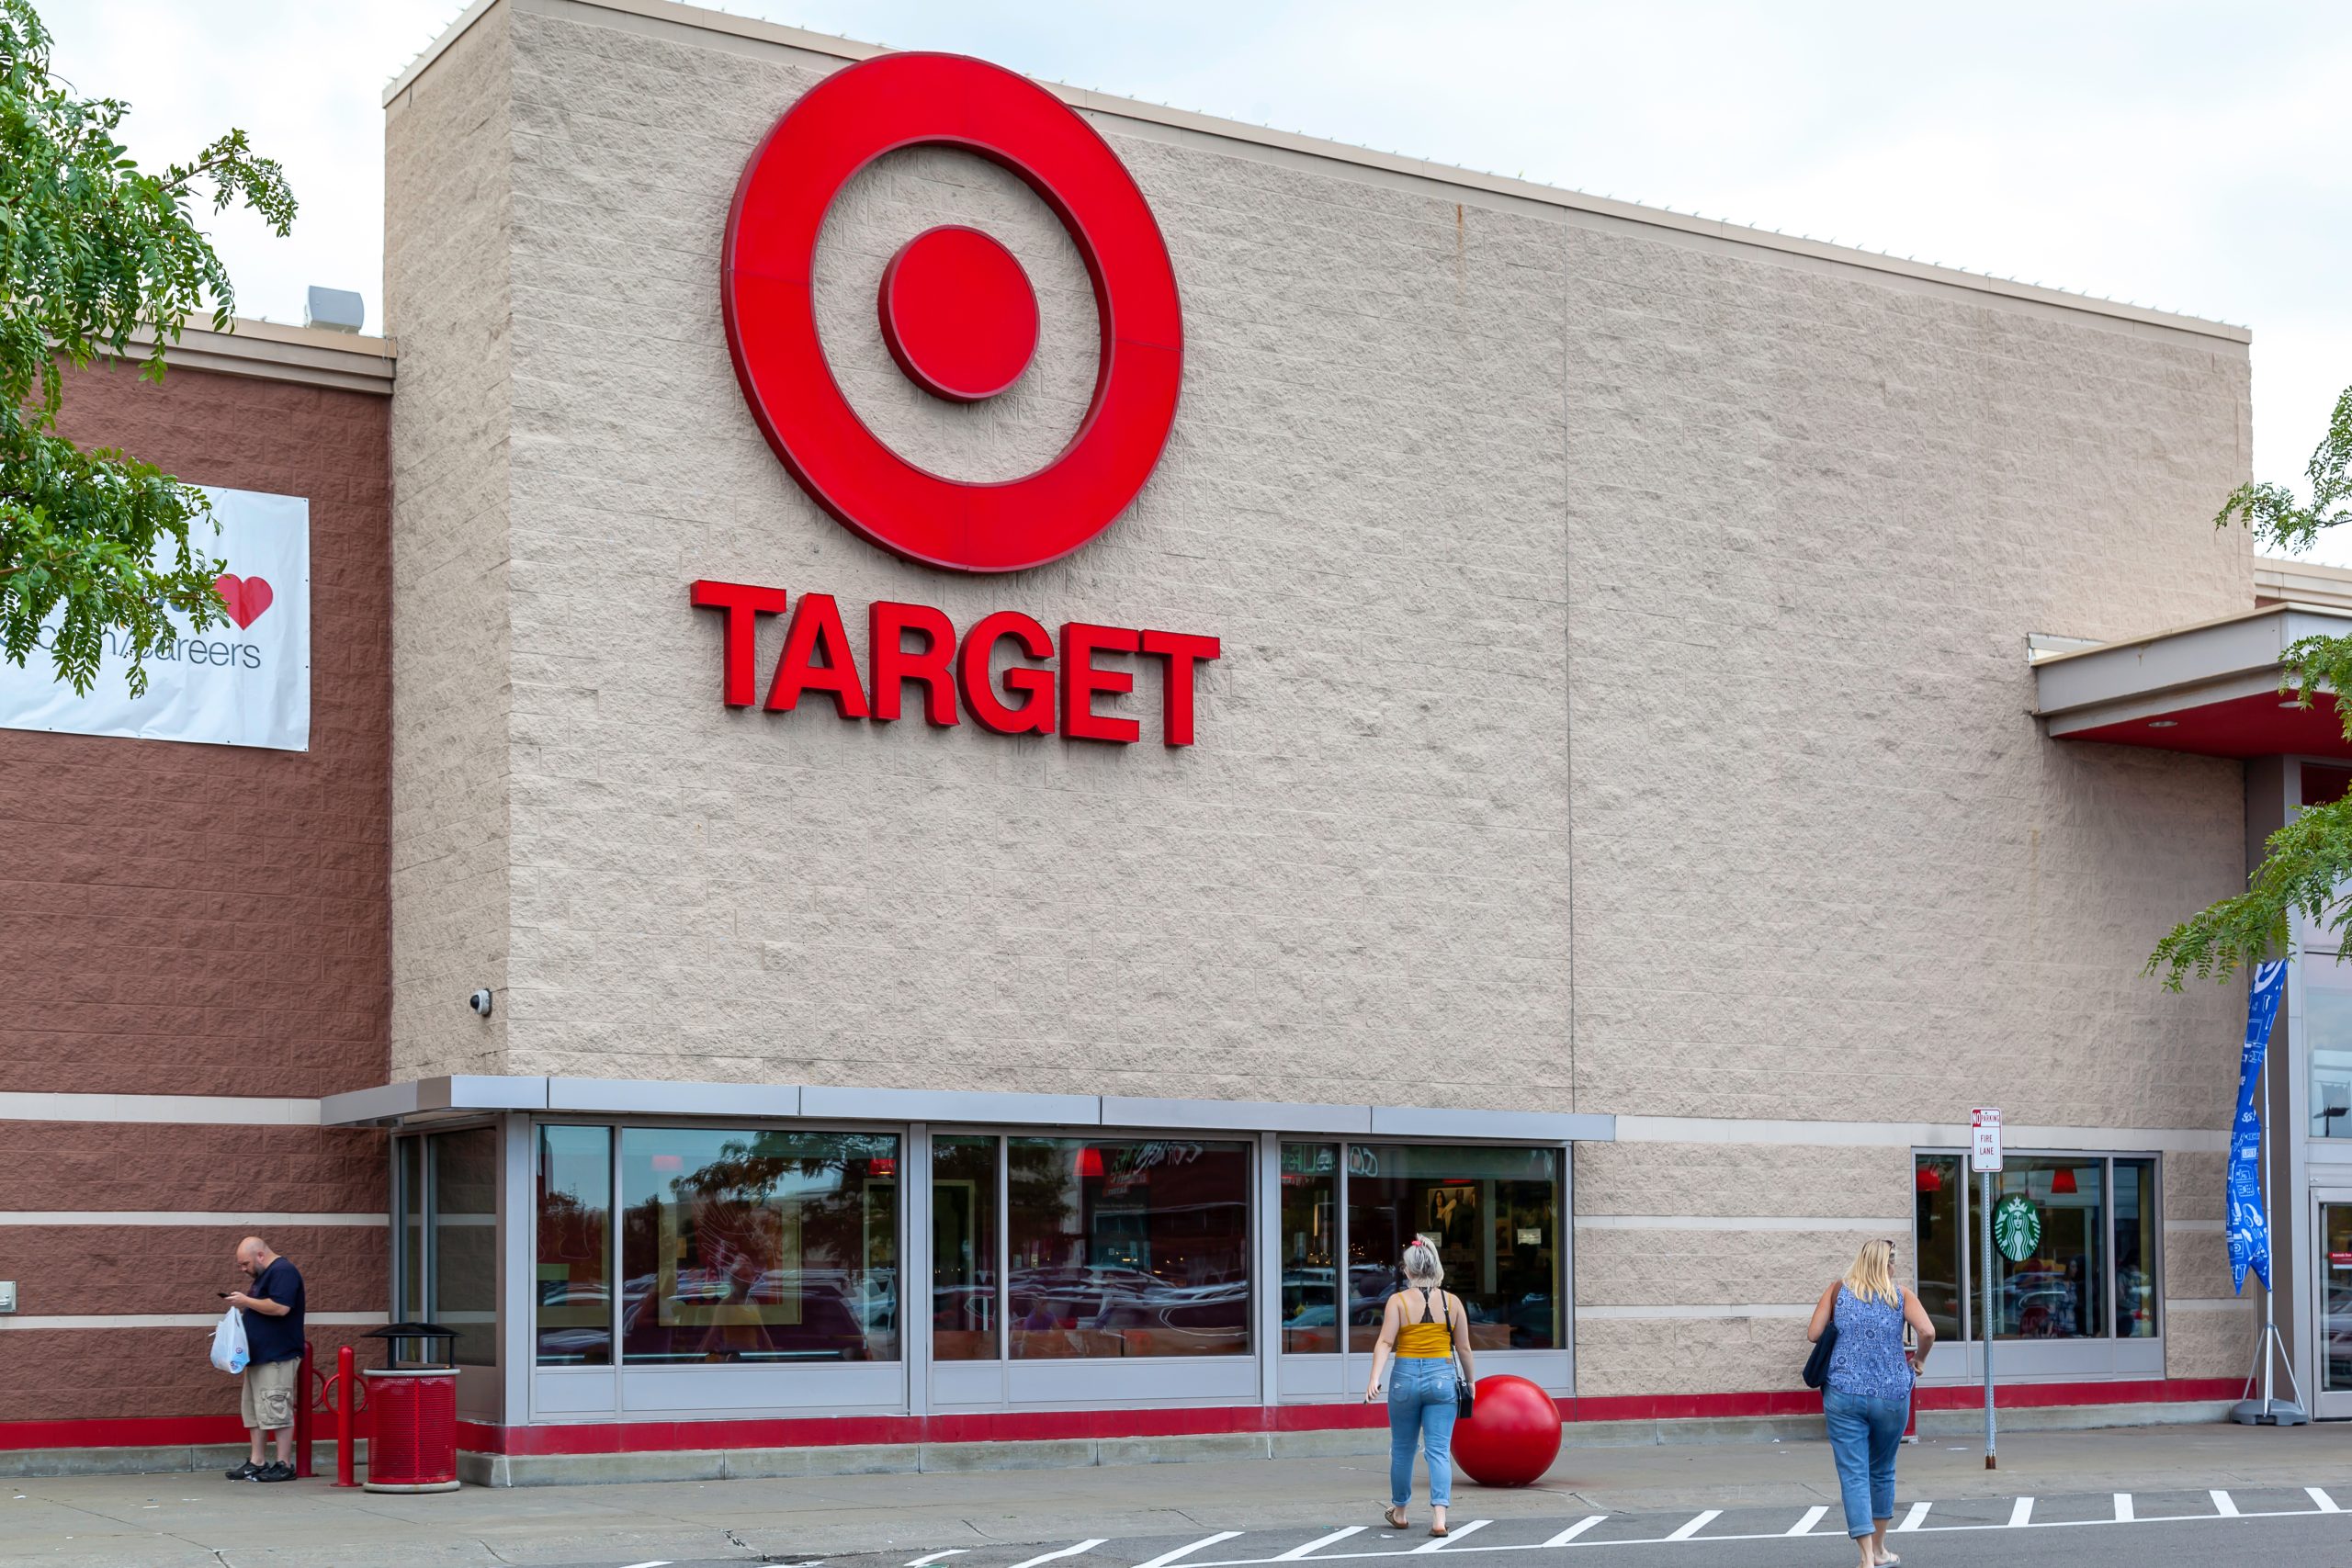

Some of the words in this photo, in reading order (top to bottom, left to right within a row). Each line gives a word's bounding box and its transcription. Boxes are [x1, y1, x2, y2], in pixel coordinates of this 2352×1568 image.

[690, 580, 1221, 747] TARGET
[1972, 1112, 1981, 1124] NO
[1981, 1114, 1999, 1122] PARKING
[1980, 1134, 1993, 1143] FIRE
[1979, 1147, 1994, 1156] LANE
